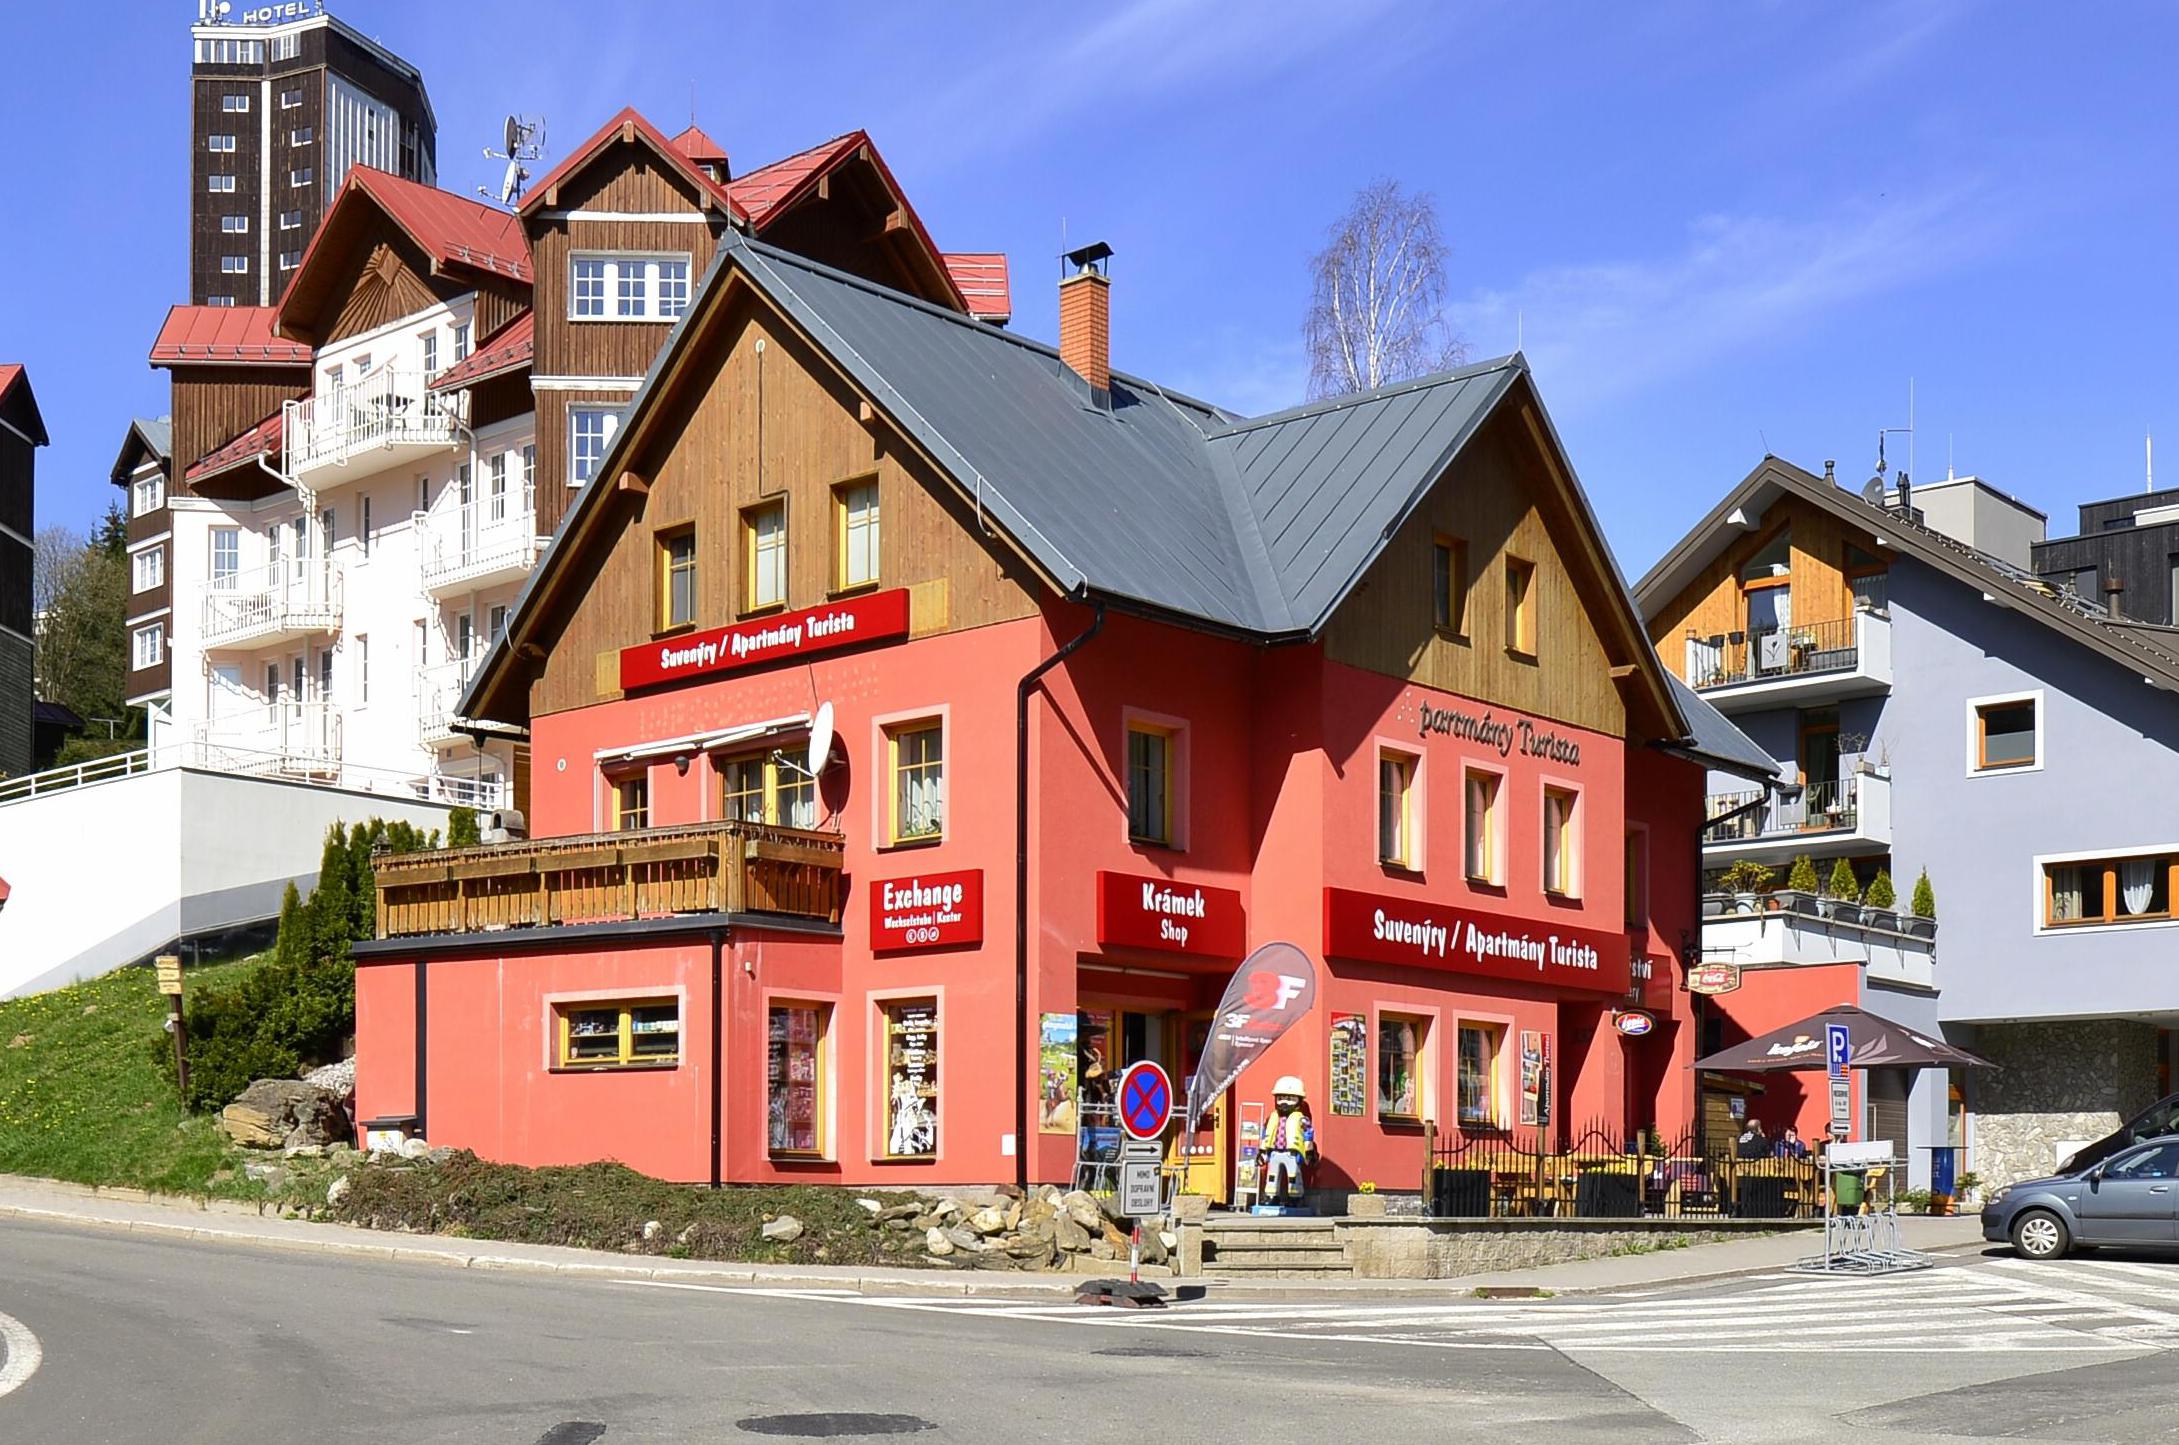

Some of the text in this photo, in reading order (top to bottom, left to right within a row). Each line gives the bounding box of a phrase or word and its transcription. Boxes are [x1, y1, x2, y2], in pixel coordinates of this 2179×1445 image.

[243, 1, 310, 23] HOTEL
[660, 612, 855, 670] Suvenýry / Apartmány Turista
[1517, 718, 1580, 767] Turista
[883, 879, 963, 912] Exchange
[1142, 882, 1206, 918] Krámek
[1160, 919, 1188, 948] Shop
[1373, 909, 1598, 971] Suvenýry / Apartmány Turista
[1243, 970, 1306, 1010] 3F
[1224, 1013, 1251, 1029] 3F
[1831, 1031, 1845, 1063] P
